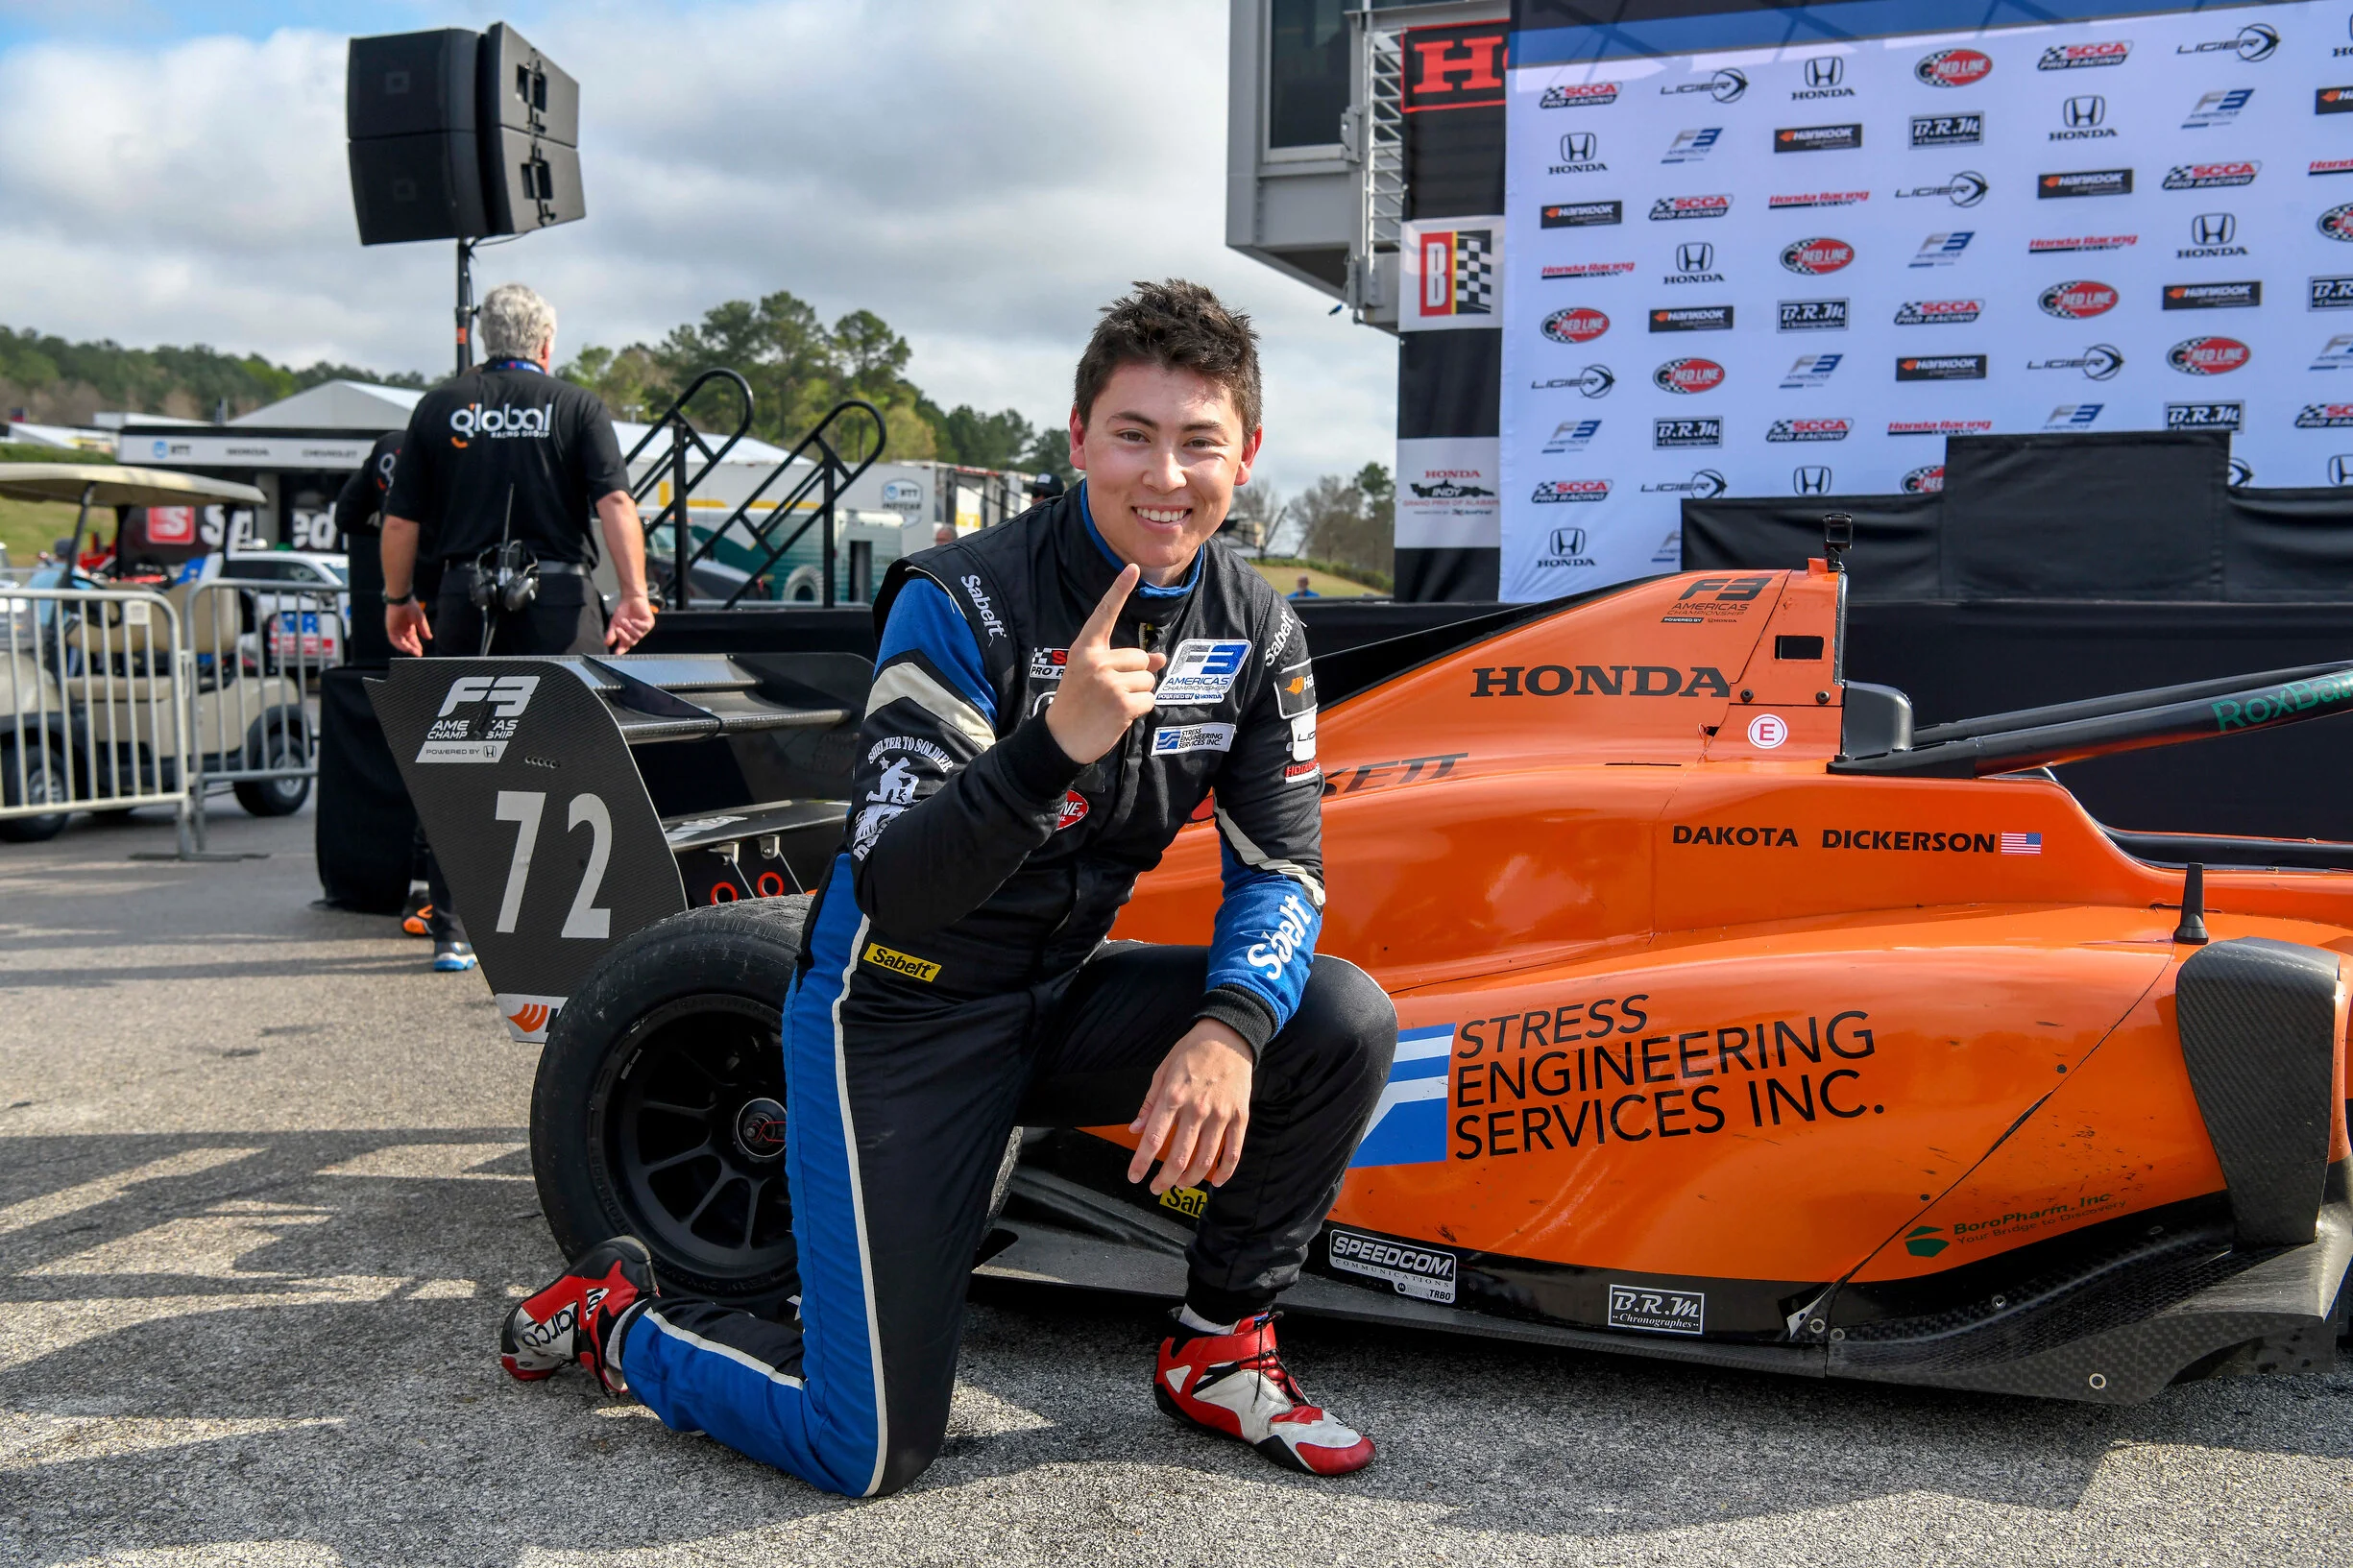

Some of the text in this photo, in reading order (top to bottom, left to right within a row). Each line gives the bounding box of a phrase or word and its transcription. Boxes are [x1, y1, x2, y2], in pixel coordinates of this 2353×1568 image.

[2067, 43, 2126, 58] SCCA
[1937, 59, 1986, 73] RED LINE
[1565, 84, 1617, 97] SCCA
[1791, 88, 1856, 101] HONDA
[2193, 88, 2255, 111] F3
[1670, 128, 1723, 148] F3
[2049, 129, 2118, 141] HONDA
[1548, 163, 1608, 175] HONDA
[2193, 163, 2254, 177] SCCA
[1674, 196, 1727, 209] SCCA
[1769, 194, 1817, 205] Honda
[1819, 191, 1869, 203] Racing
[1921, 231, 1976, 251] F3
[2029, 238, 2080, 249] Honda
[2083, 234, 2139, 246] Racing
[1801, 248, 1848, 262] RED LINE
[2176, 247, 2248, 259] HONDA
[1542, 265, 1586, 276] Honda
[1588, 262, 1635, 273] Racing
[1663, 274, 1725, 284] HONDA
[2062, 292, 2112, 305] RED LINE
[1921, 301, 1979, 315] SCCA
[1561, 318, 1605, 331] RED LINE
[2191, 348, 2244, 362] RED LINE
[1789, 354, 1844, 374] F3
[1674, 368, 1719, 381] RED LINE
[2047, 404, 2104, 422] F3
[1552, 420, 1602, 439] F3
[1793, 420, 1848, 432] SCCA
[1888, 421, 1992, 431] Honda Racing
[1556, 481, 1607, 494] SCCA
[1537, 559, 1597, 568] HONDA
[1678, 578, 1773, 601] F3
[961, 574, 1007, 647] Sabelt
[1265, 608, 1295, 667] Sabelt
[1171, 645, 1247, 674] F3
[1031, 666, 1053, 676] PRO
[1470, 664, 1731, 698] HONDA
[438, 676, 541, 717] F3
[431, 720, 519, 731] AMEAS
[1759, 723, 1775, 740] E
[427, 731, 514, 739] CHAMPSHIP
[1180, 733, 1224, 742] ENGINEERING
[1178, 739, 1205, 749] SERVICES
[868, 736, 954, 773] SHELTER TO SOLDIER
[1672, 824, 1996, 854] DAKOTA DICKERSON
[496, 790, 613, 940] 72
[871, 946, 936, 979] Sabelt
[1457, 994, 1650, 1060] STRESS
[1457, 1009, 1876, 1109] ENGINEERING
[1454, 1068, 1885, 1161] SERVICES INC.
[1957, 1200, 2126, 1244] Your Bridge to Discovery
[1332, 1236, 1452, 1277] SPEEDCOM
[1335, 1258, 1449, 1289] COMMUNICATIONS
[1429, 1289, 1452, 1301] TRBO
[1613, 1291, 1700, 1317] B.R.M
[1619, 1313, 1692, 1329] Chronographes
